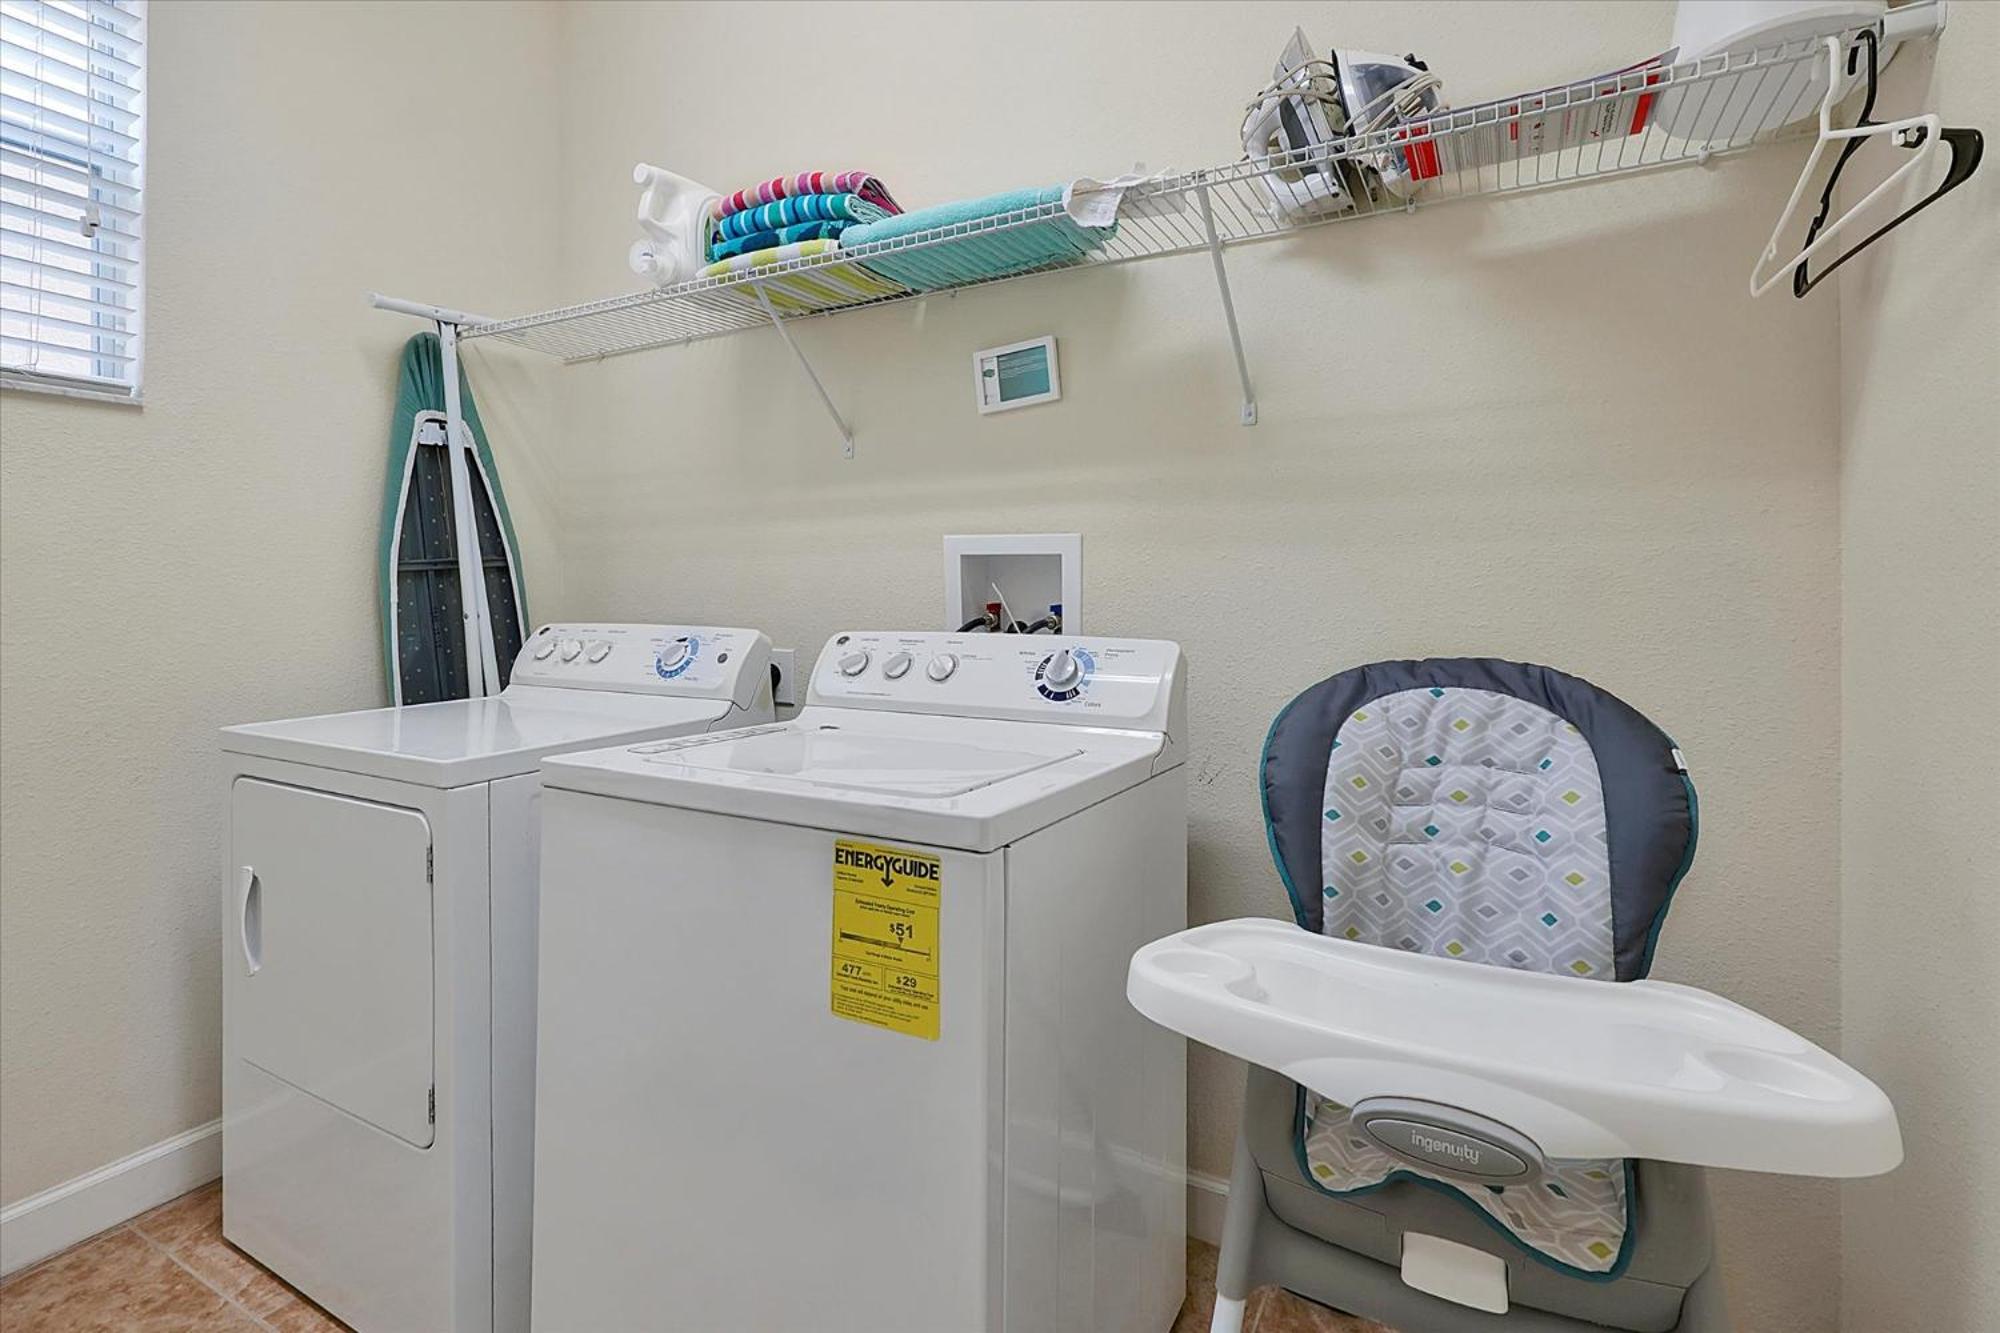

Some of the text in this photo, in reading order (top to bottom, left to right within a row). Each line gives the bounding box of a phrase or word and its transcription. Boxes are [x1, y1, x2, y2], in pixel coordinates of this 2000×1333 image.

[835, 847, 940, 882] ENERGYGUIDE
[889, 922, 913, 939] $51
[842, 963, 862, 976] 477
[1411, 1129, 1481, 1165] ingenuity
